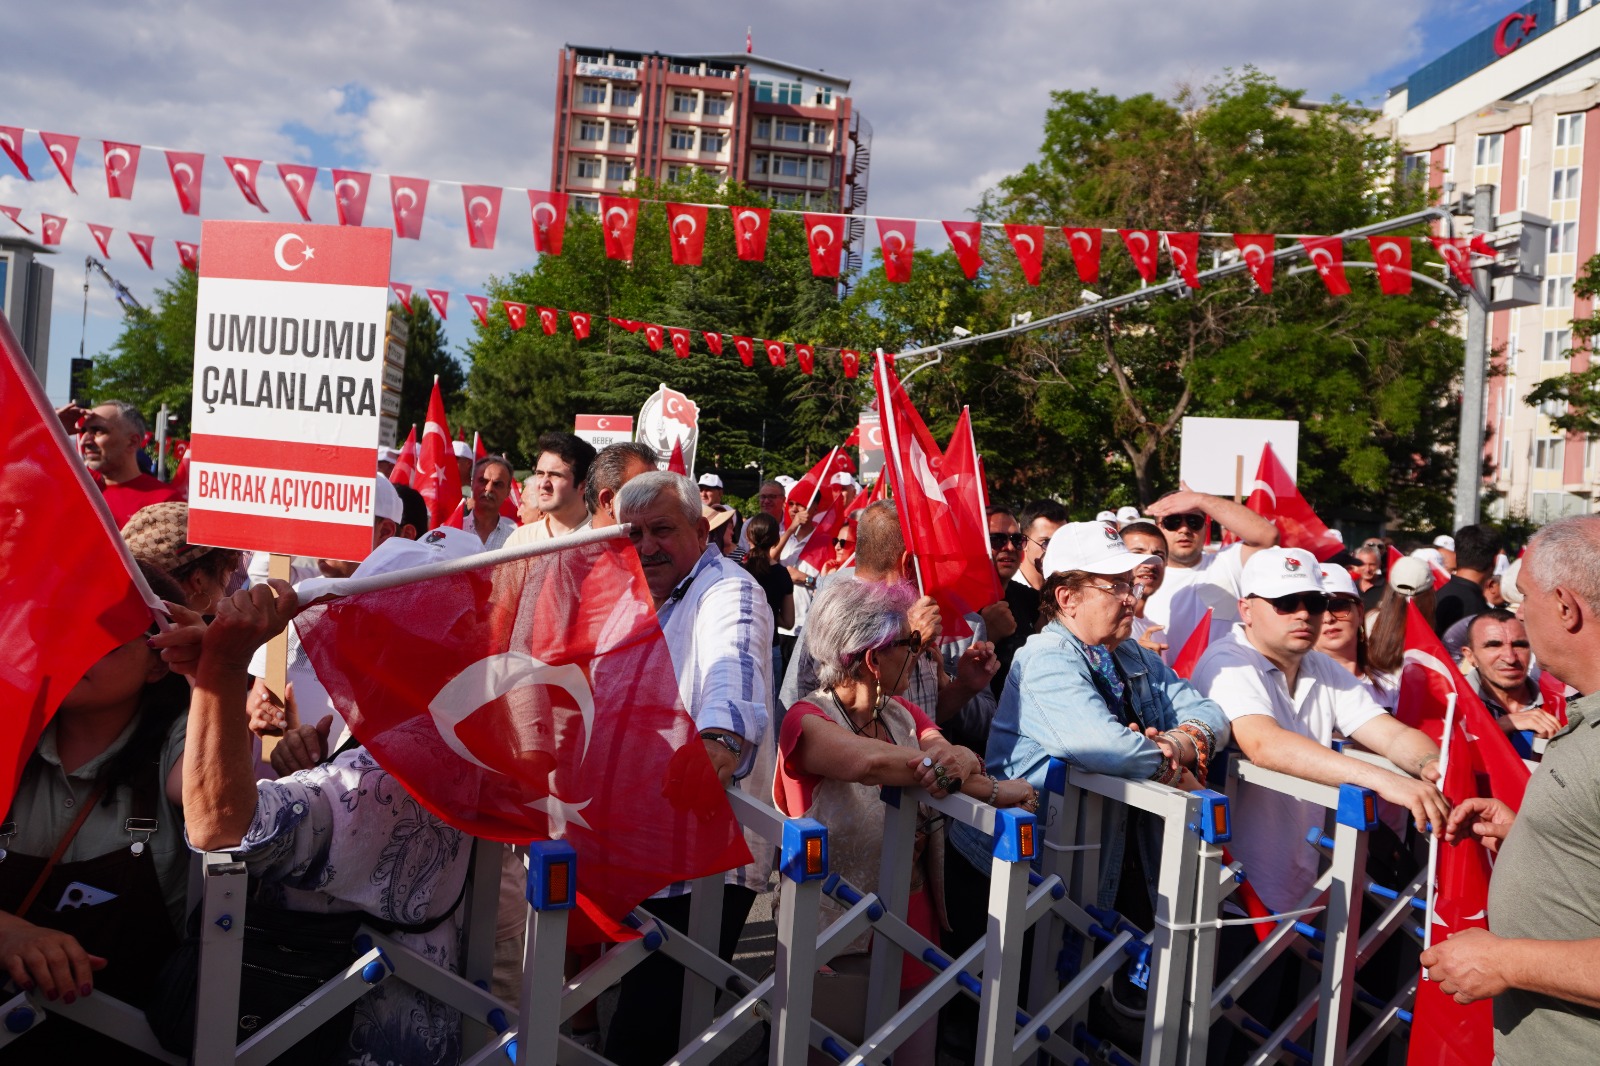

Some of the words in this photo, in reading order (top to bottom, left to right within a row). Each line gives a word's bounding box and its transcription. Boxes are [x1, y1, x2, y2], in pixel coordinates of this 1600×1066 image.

[208, 313, 377, 362] UMUDUMU
[202, 366, 377, 417] ÇALANLARA
[592, 437, 614, 445] BEBEK
[198, 470, 266, 504] BAYRAK
[269, 477, 371, 514] AÇIYORUM!
